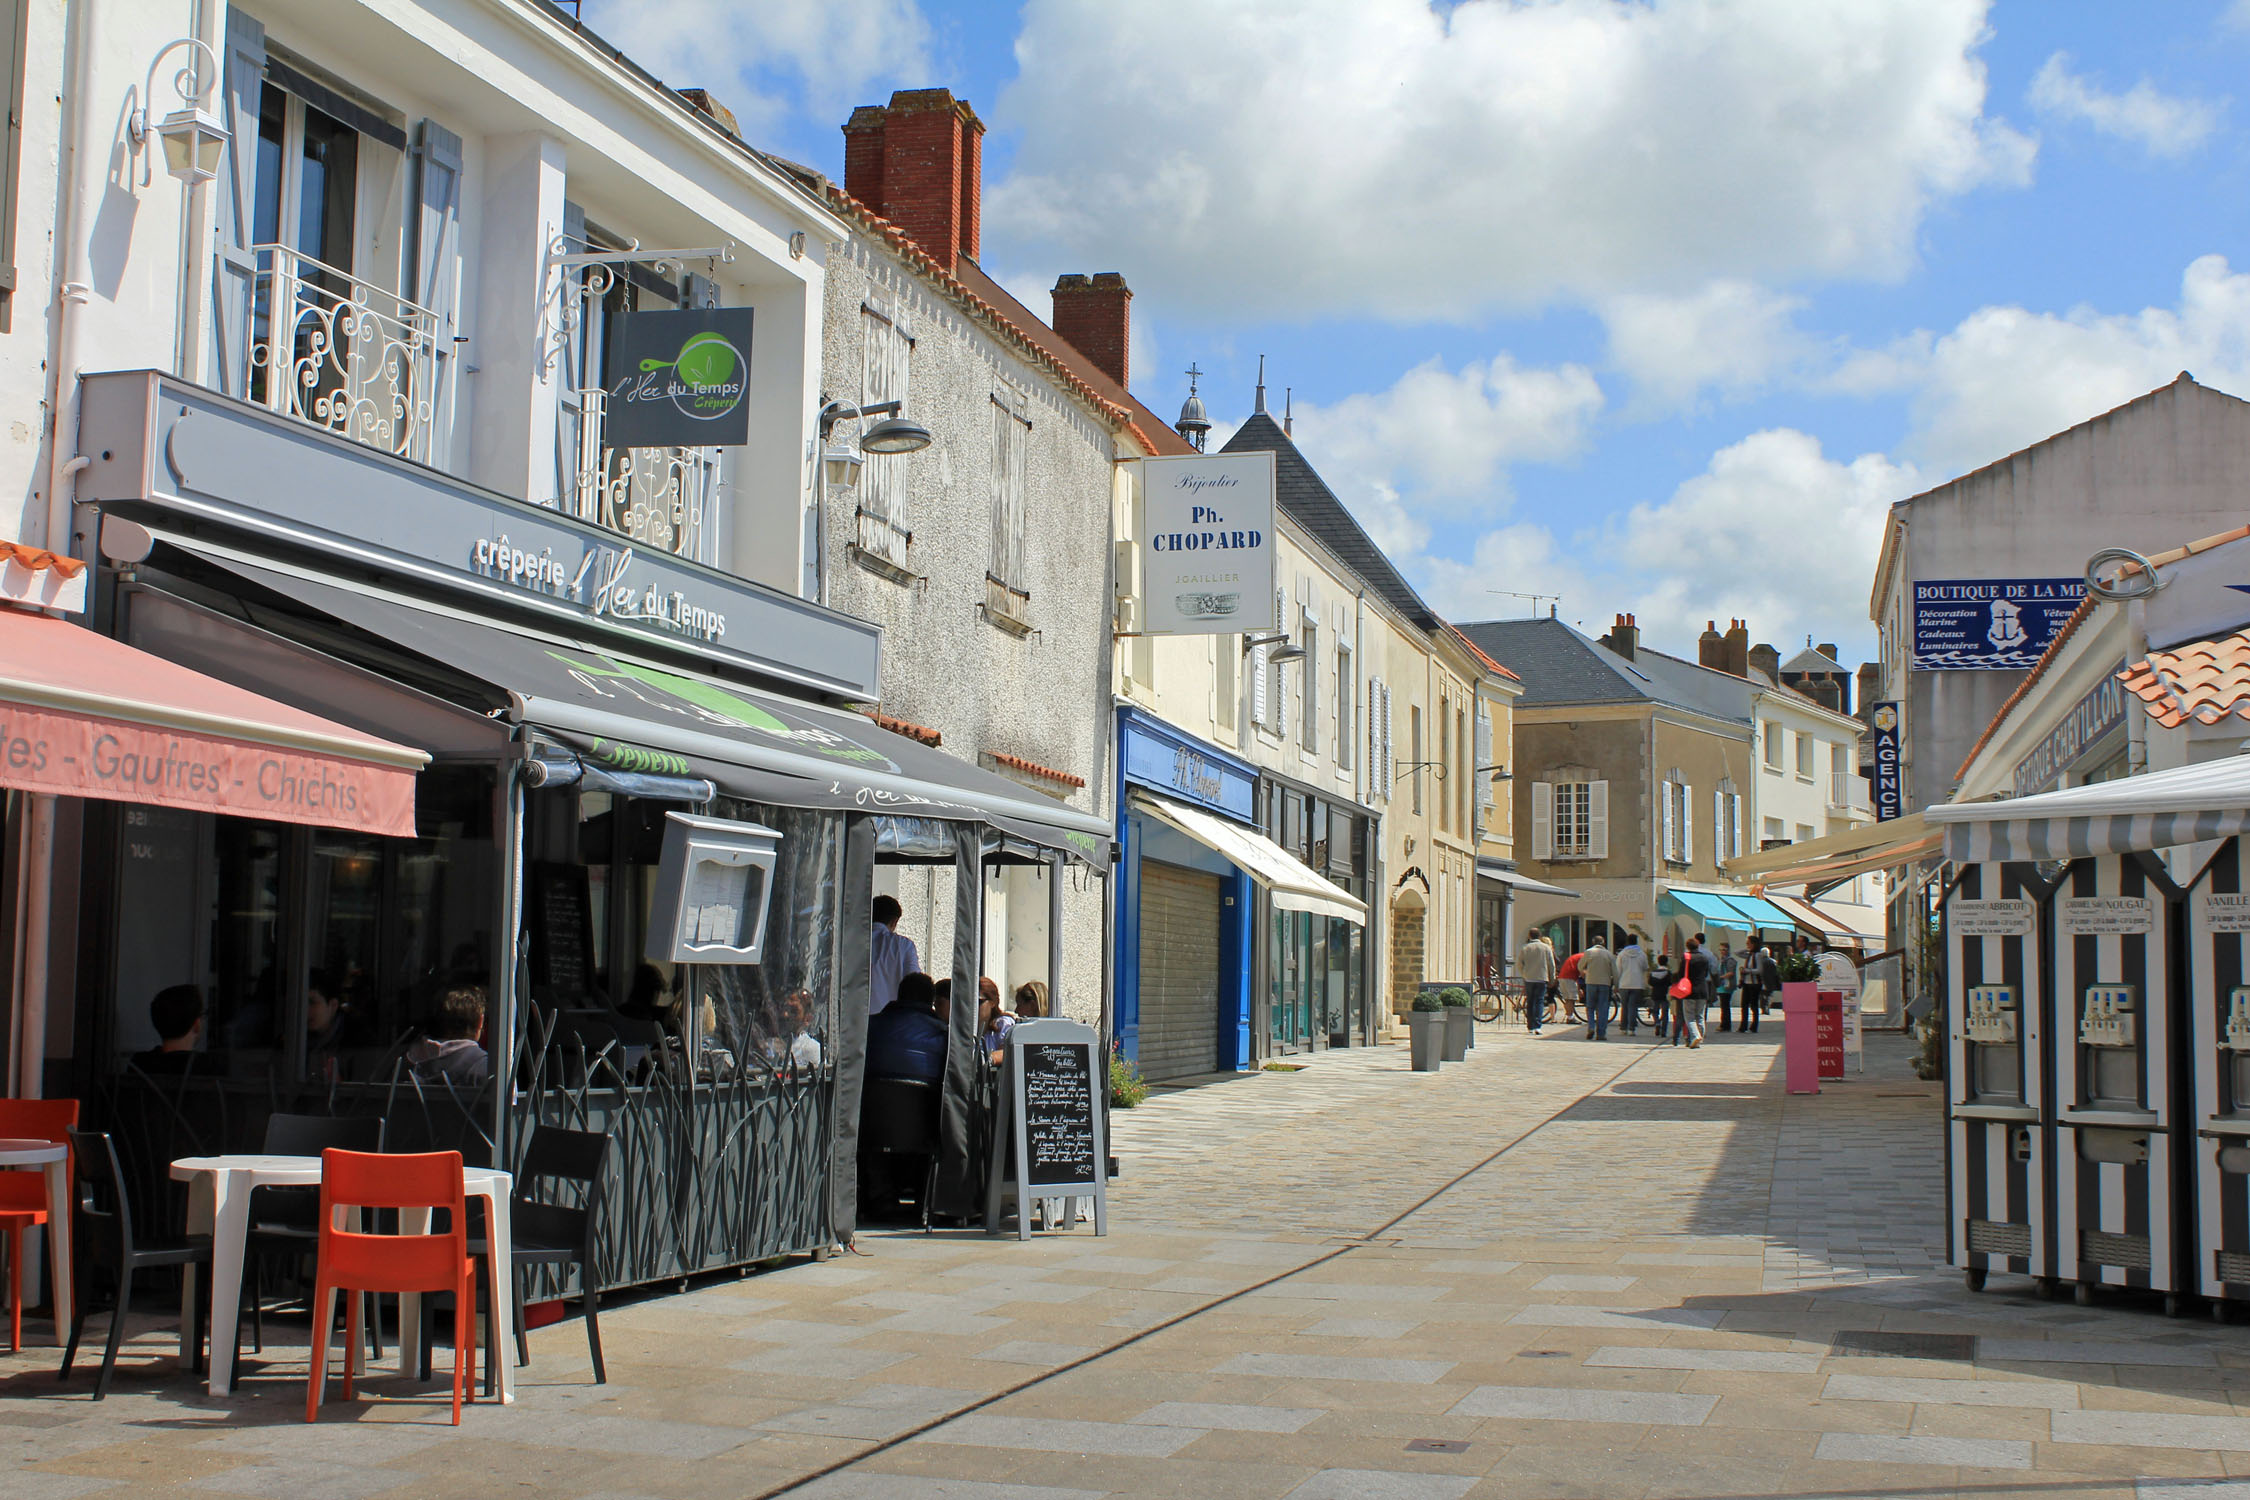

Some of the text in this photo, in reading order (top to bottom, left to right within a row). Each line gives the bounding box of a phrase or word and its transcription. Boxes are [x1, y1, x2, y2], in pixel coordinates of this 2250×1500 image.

[667, 381, 686, 394] du
[692, 381, 739, 397] Temps
[1174, 472, 1239, 495] Bijoutier
[1191, 506, 1224, 524] Ph.
[1152, 530, 1262, 552] CHOPARD
[1175, 573, 1240, 584] JOAILLIER
[476, 534, 565, 587] crêperie
[645, 583, 668, 617] du
[673, 591, 726, 641] Temps
[1917, 584, 2088, 600] BOUTIQUE DE LA ME
[1918, 608, 1978, 618] Décoration
[1918, 618, 1958, 627] Marine
[1918, 630, 1966, 639] Cadeaux
[1918, 642, 1979, 650] Luminaires
[2054, 670, 2122, 768] CHEVILLON
[92, 734, 220, 793] Gaufres
[257, 760, 357, 812] Chichis
[1878, 735, 1897, 818] AGENCE
[1990, 902, 2024, 911] ABRICOT
[2105, 900, 2144, 909] NOUGAT
[2206, 895, 2249, 906] VANILLE
